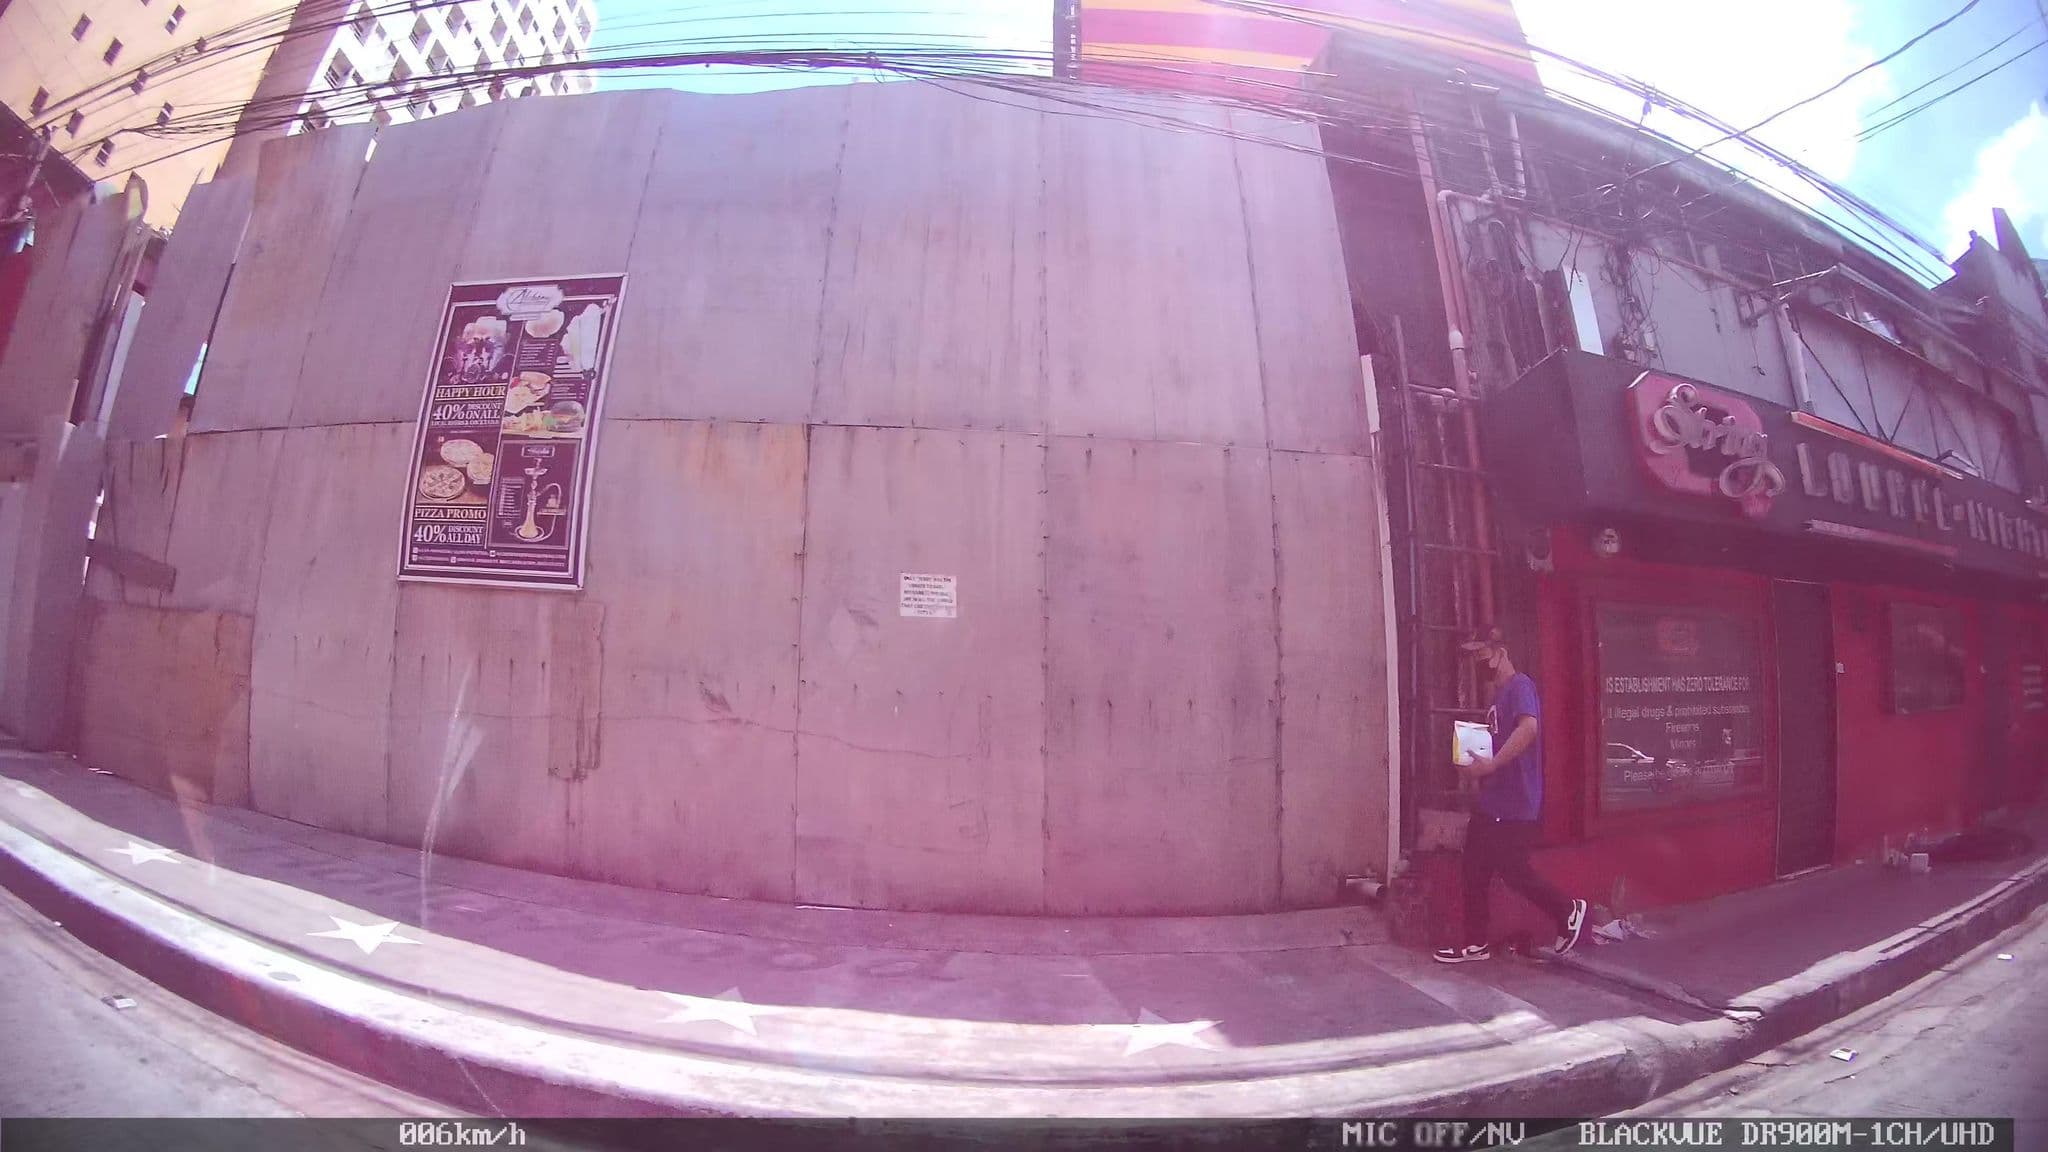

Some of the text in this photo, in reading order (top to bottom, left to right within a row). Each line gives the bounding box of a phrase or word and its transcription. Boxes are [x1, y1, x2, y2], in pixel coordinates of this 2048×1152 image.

[435, 386, 506, 398] HAPPY HOUR
[467, 402, 503, 410] DISCOUNT
[432, 404, 466, 421] 40%
[480, 409, 500, 419] ALL
[414, 508, 487, 519] PIZZA PROMO
[414, 524, 447, 542] 40%
[448, 525, 484, 533] DISCOUNT
[446, 532, 483, 544] ALL DAY
[1614, 676, 1671, 693] ESTABLISHMENT
[1641, 706, 1665, 720] drugs
